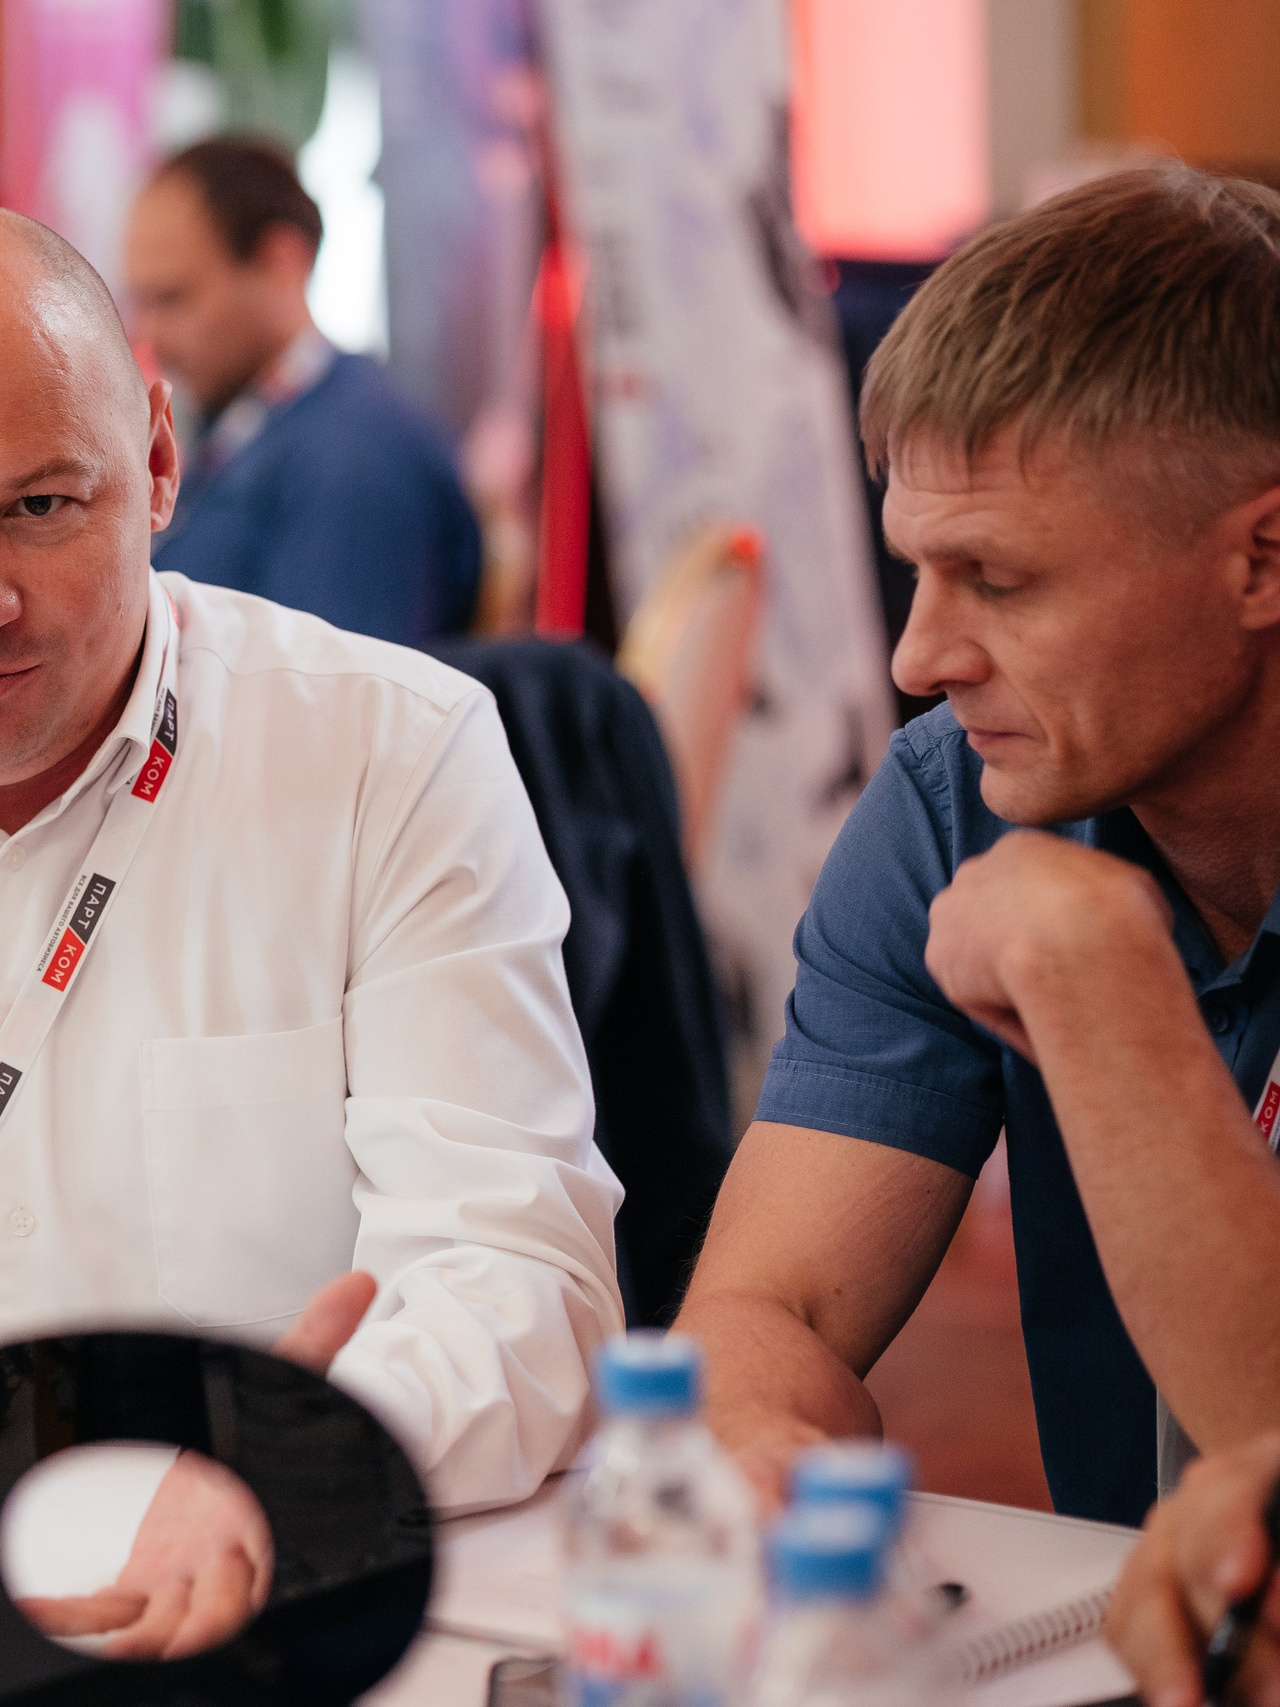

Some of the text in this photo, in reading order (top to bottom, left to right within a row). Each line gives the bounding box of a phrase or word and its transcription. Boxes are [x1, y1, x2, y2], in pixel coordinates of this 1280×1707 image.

[140, 698, 175, 795] ПАРТ КОМ
[36, 874, 88, 972] ВСЕ ДЛЯ ВАШЕГО АВТОБИЗНЕСА
[50, 882, 107, 983] ПАРТ КОМ
[1260, 1090, 1279, 1133] КОМ
